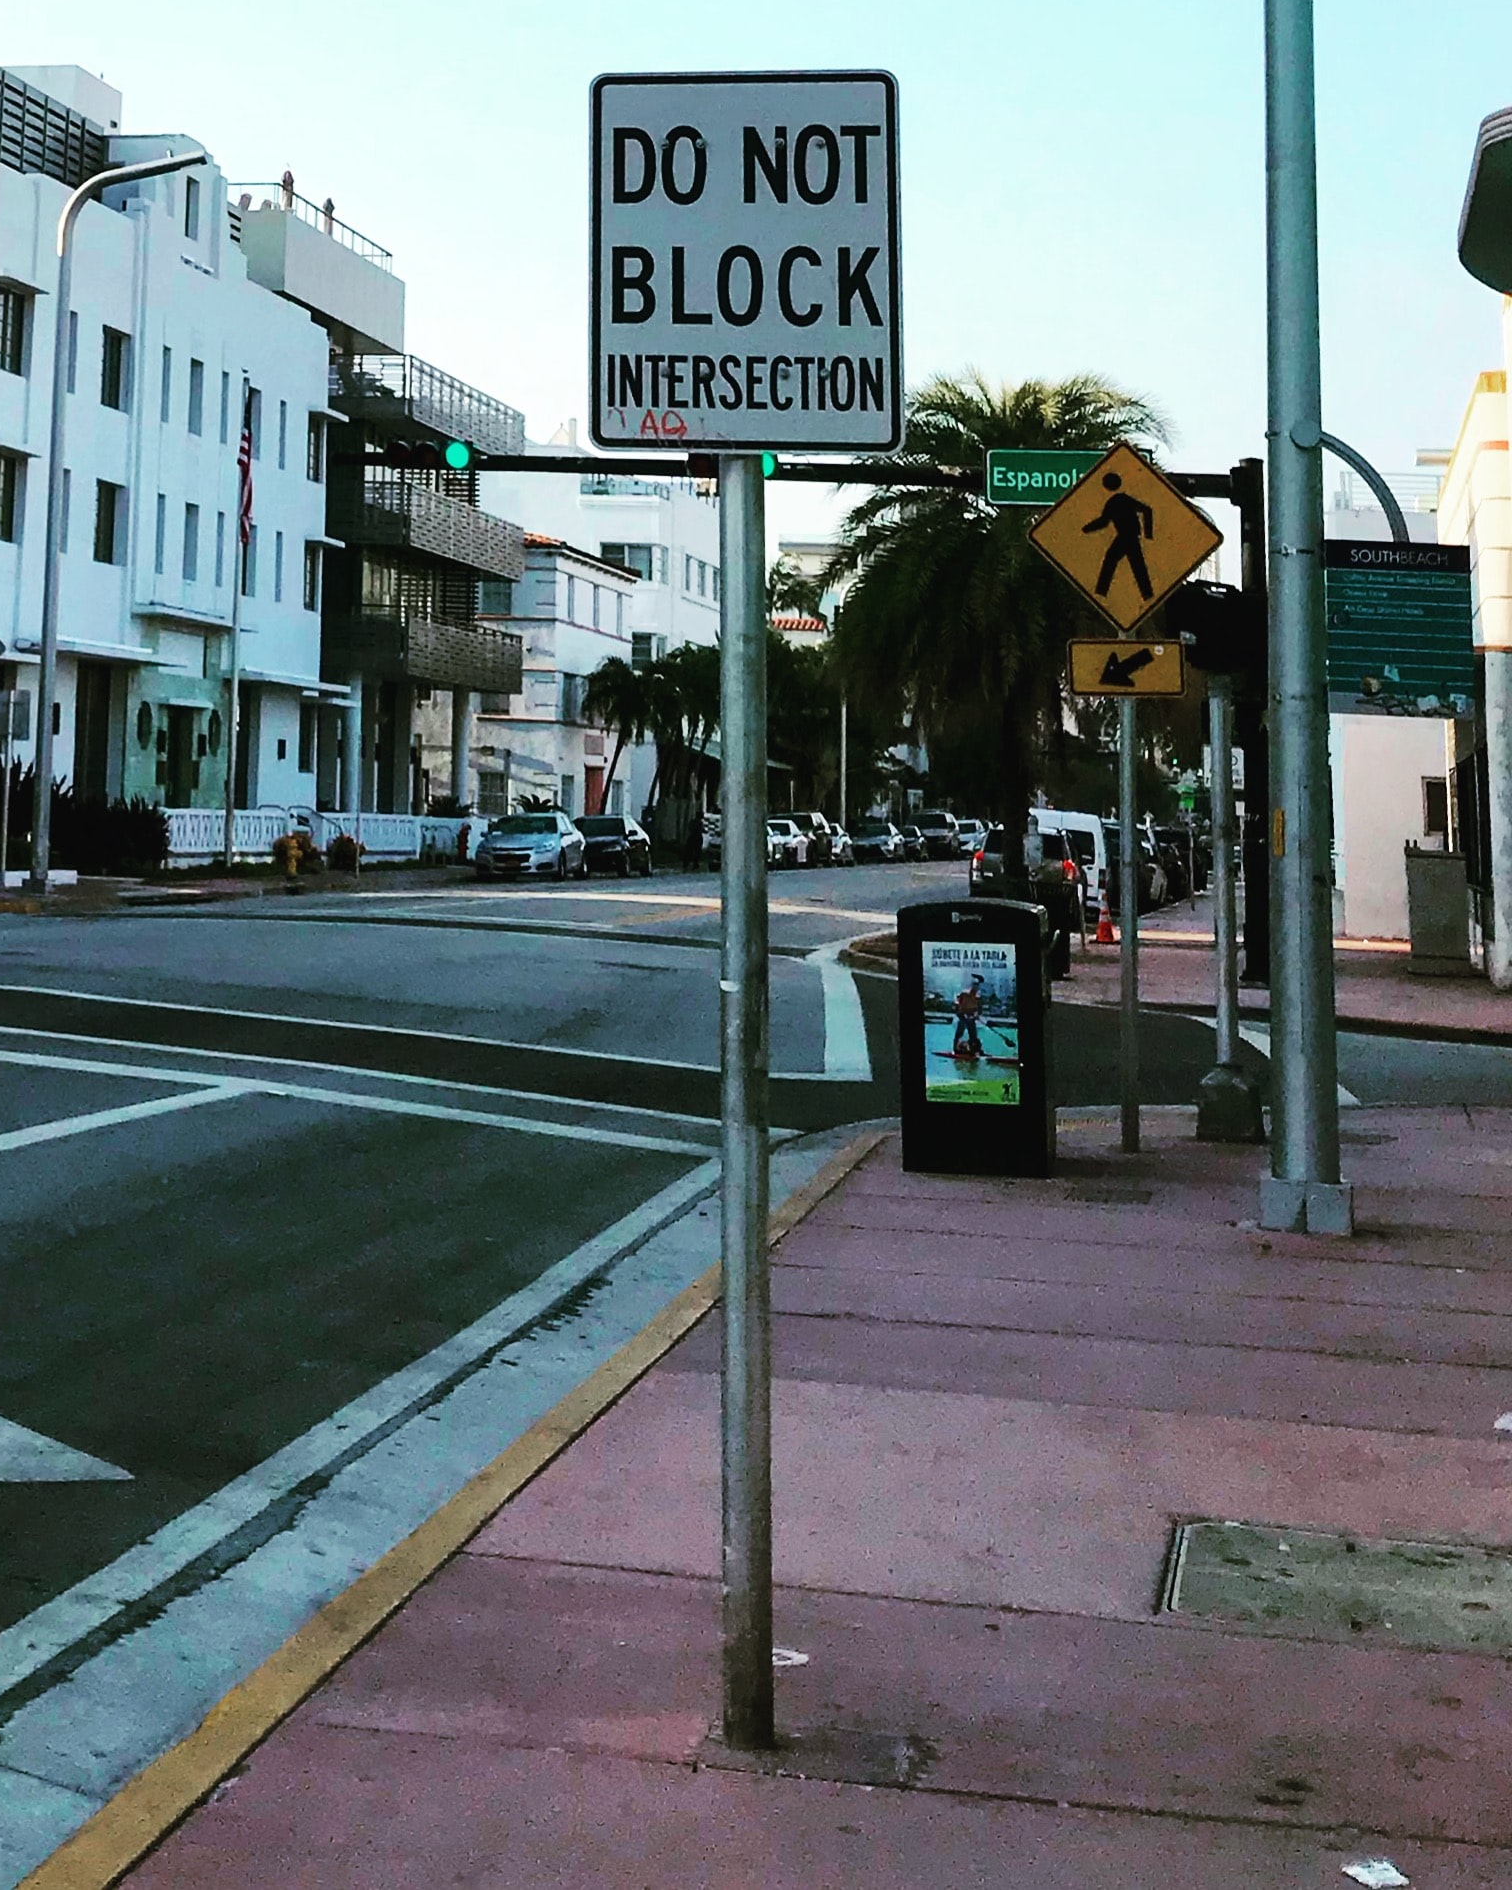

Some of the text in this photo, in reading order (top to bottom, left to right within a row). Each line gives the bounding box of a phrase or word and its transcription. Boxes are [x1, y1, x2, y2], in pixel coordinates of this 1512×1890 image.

[612, 124, 881, 206] DO NOT
[611, 245, 884, 327] BLOCK
[607, 354, 884, 412] INTERSECTION
[993, 466, 1085, 491] Espanol
